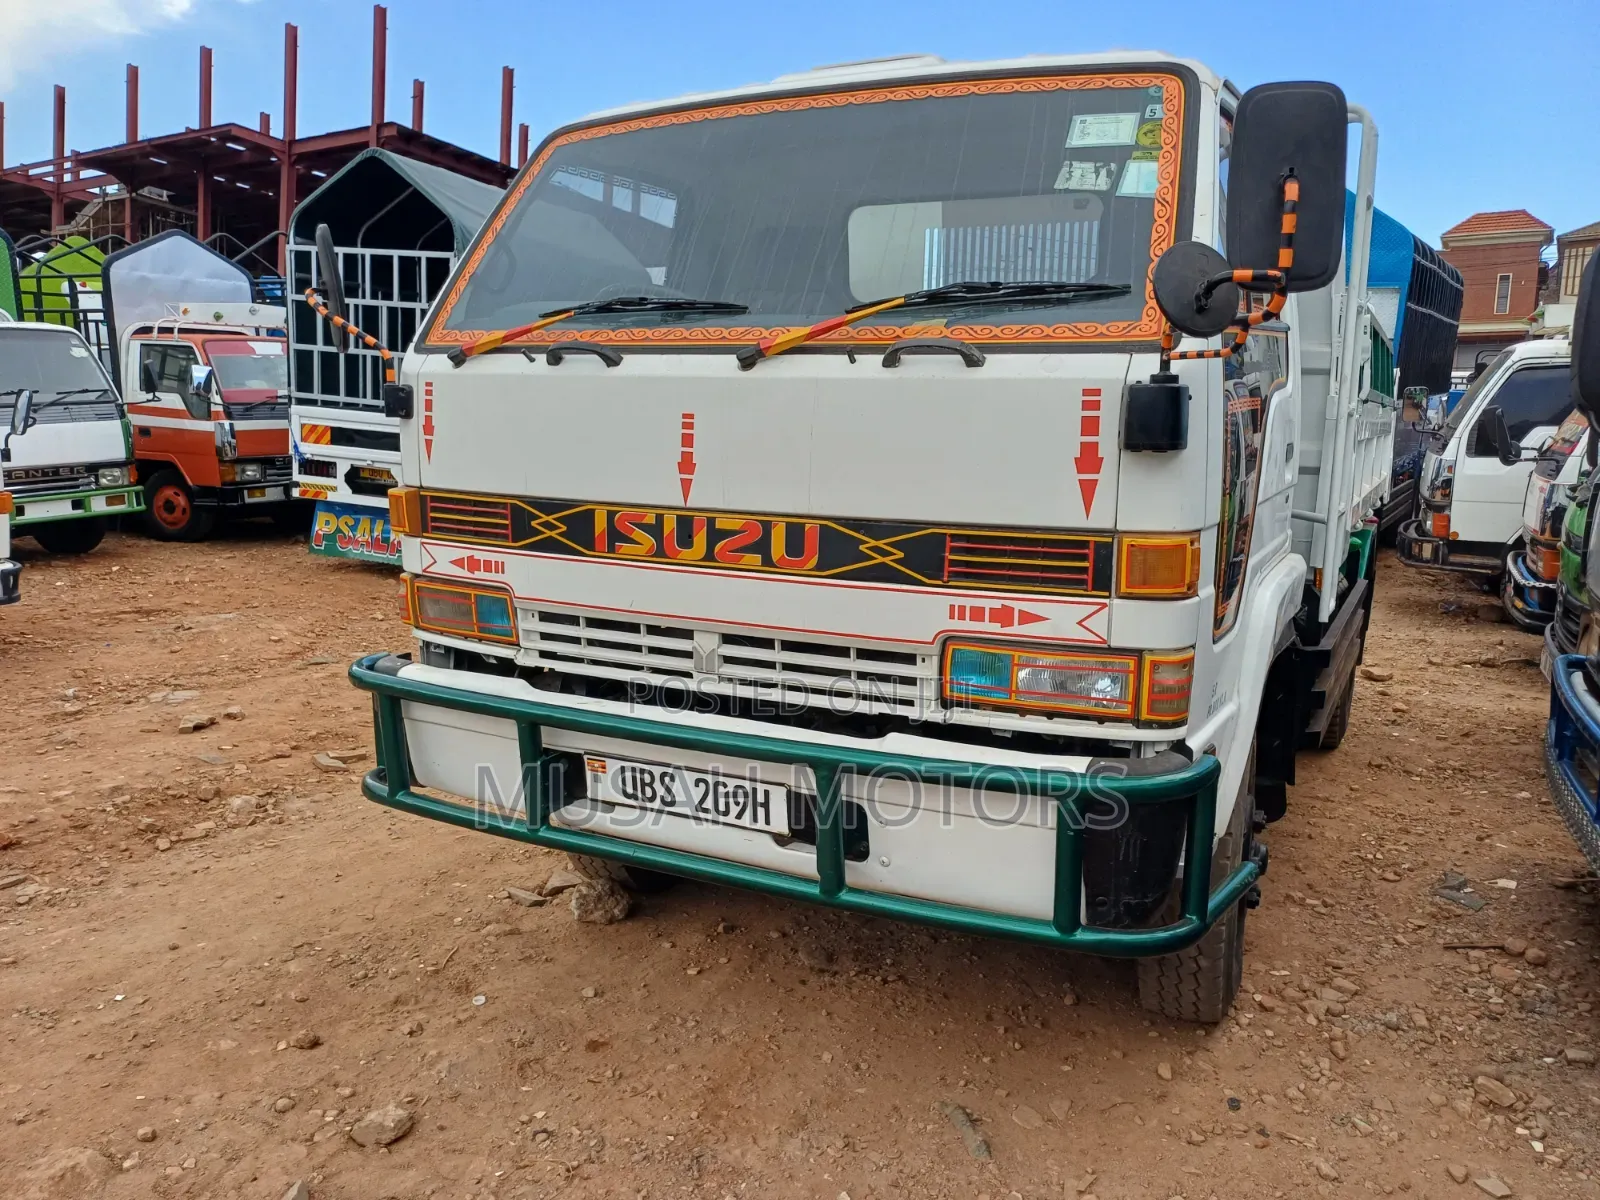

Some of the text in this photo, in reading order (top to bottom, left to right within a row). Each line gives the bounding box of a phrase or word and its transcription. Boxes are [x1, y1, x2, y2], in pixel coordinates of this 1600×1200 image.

[1148, 108, 1157, 117] 5
[594, 509, 820, 570] ISUZU
[620, 765, 771, 826] UBS 209H
